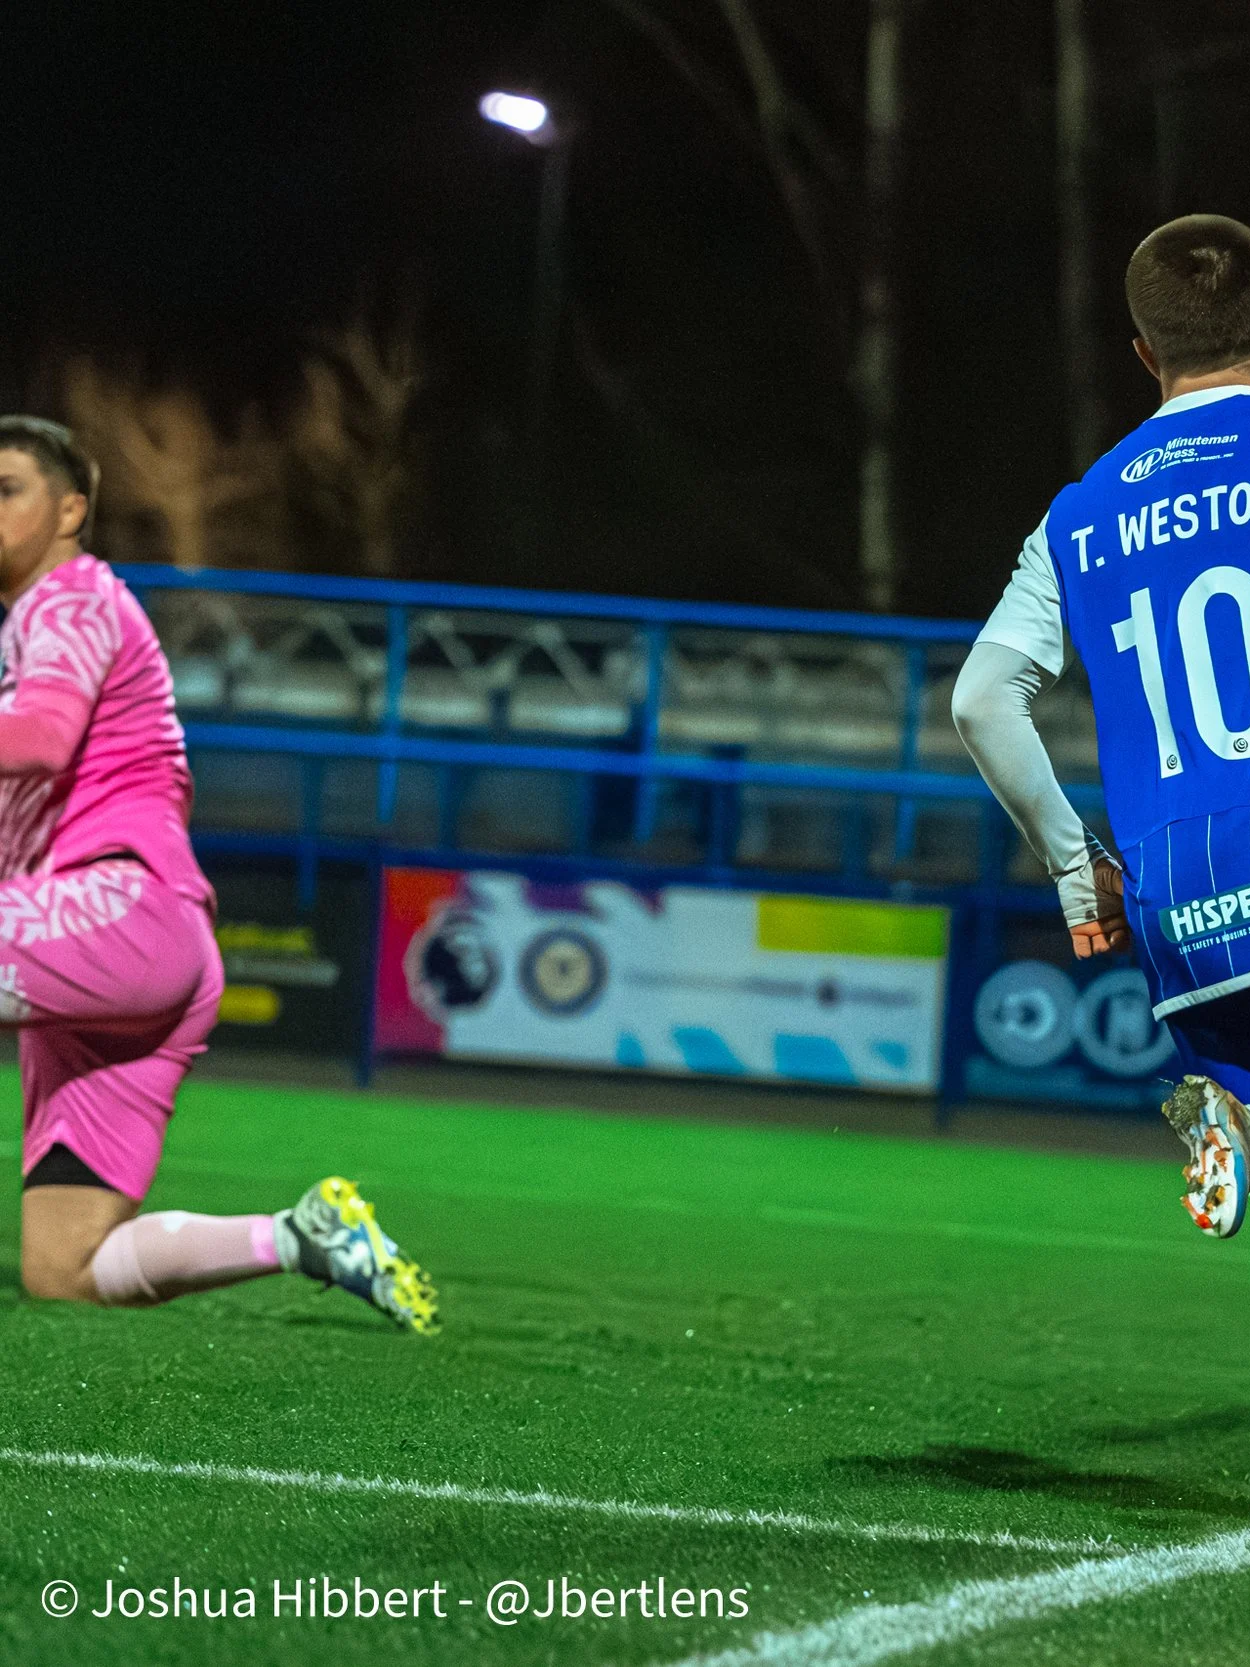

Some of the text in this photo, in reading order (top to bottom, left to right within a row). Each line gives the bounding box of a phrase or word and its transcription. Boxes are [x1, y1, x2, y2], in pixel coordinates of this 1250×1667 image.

[1165, 434, 1238, 451] Minuteman
[1071, 525, 1105, 573] T.
[1192, 938, 1214, 951] SAFETY
[1221, 928, 1248, 943] HOUSING
